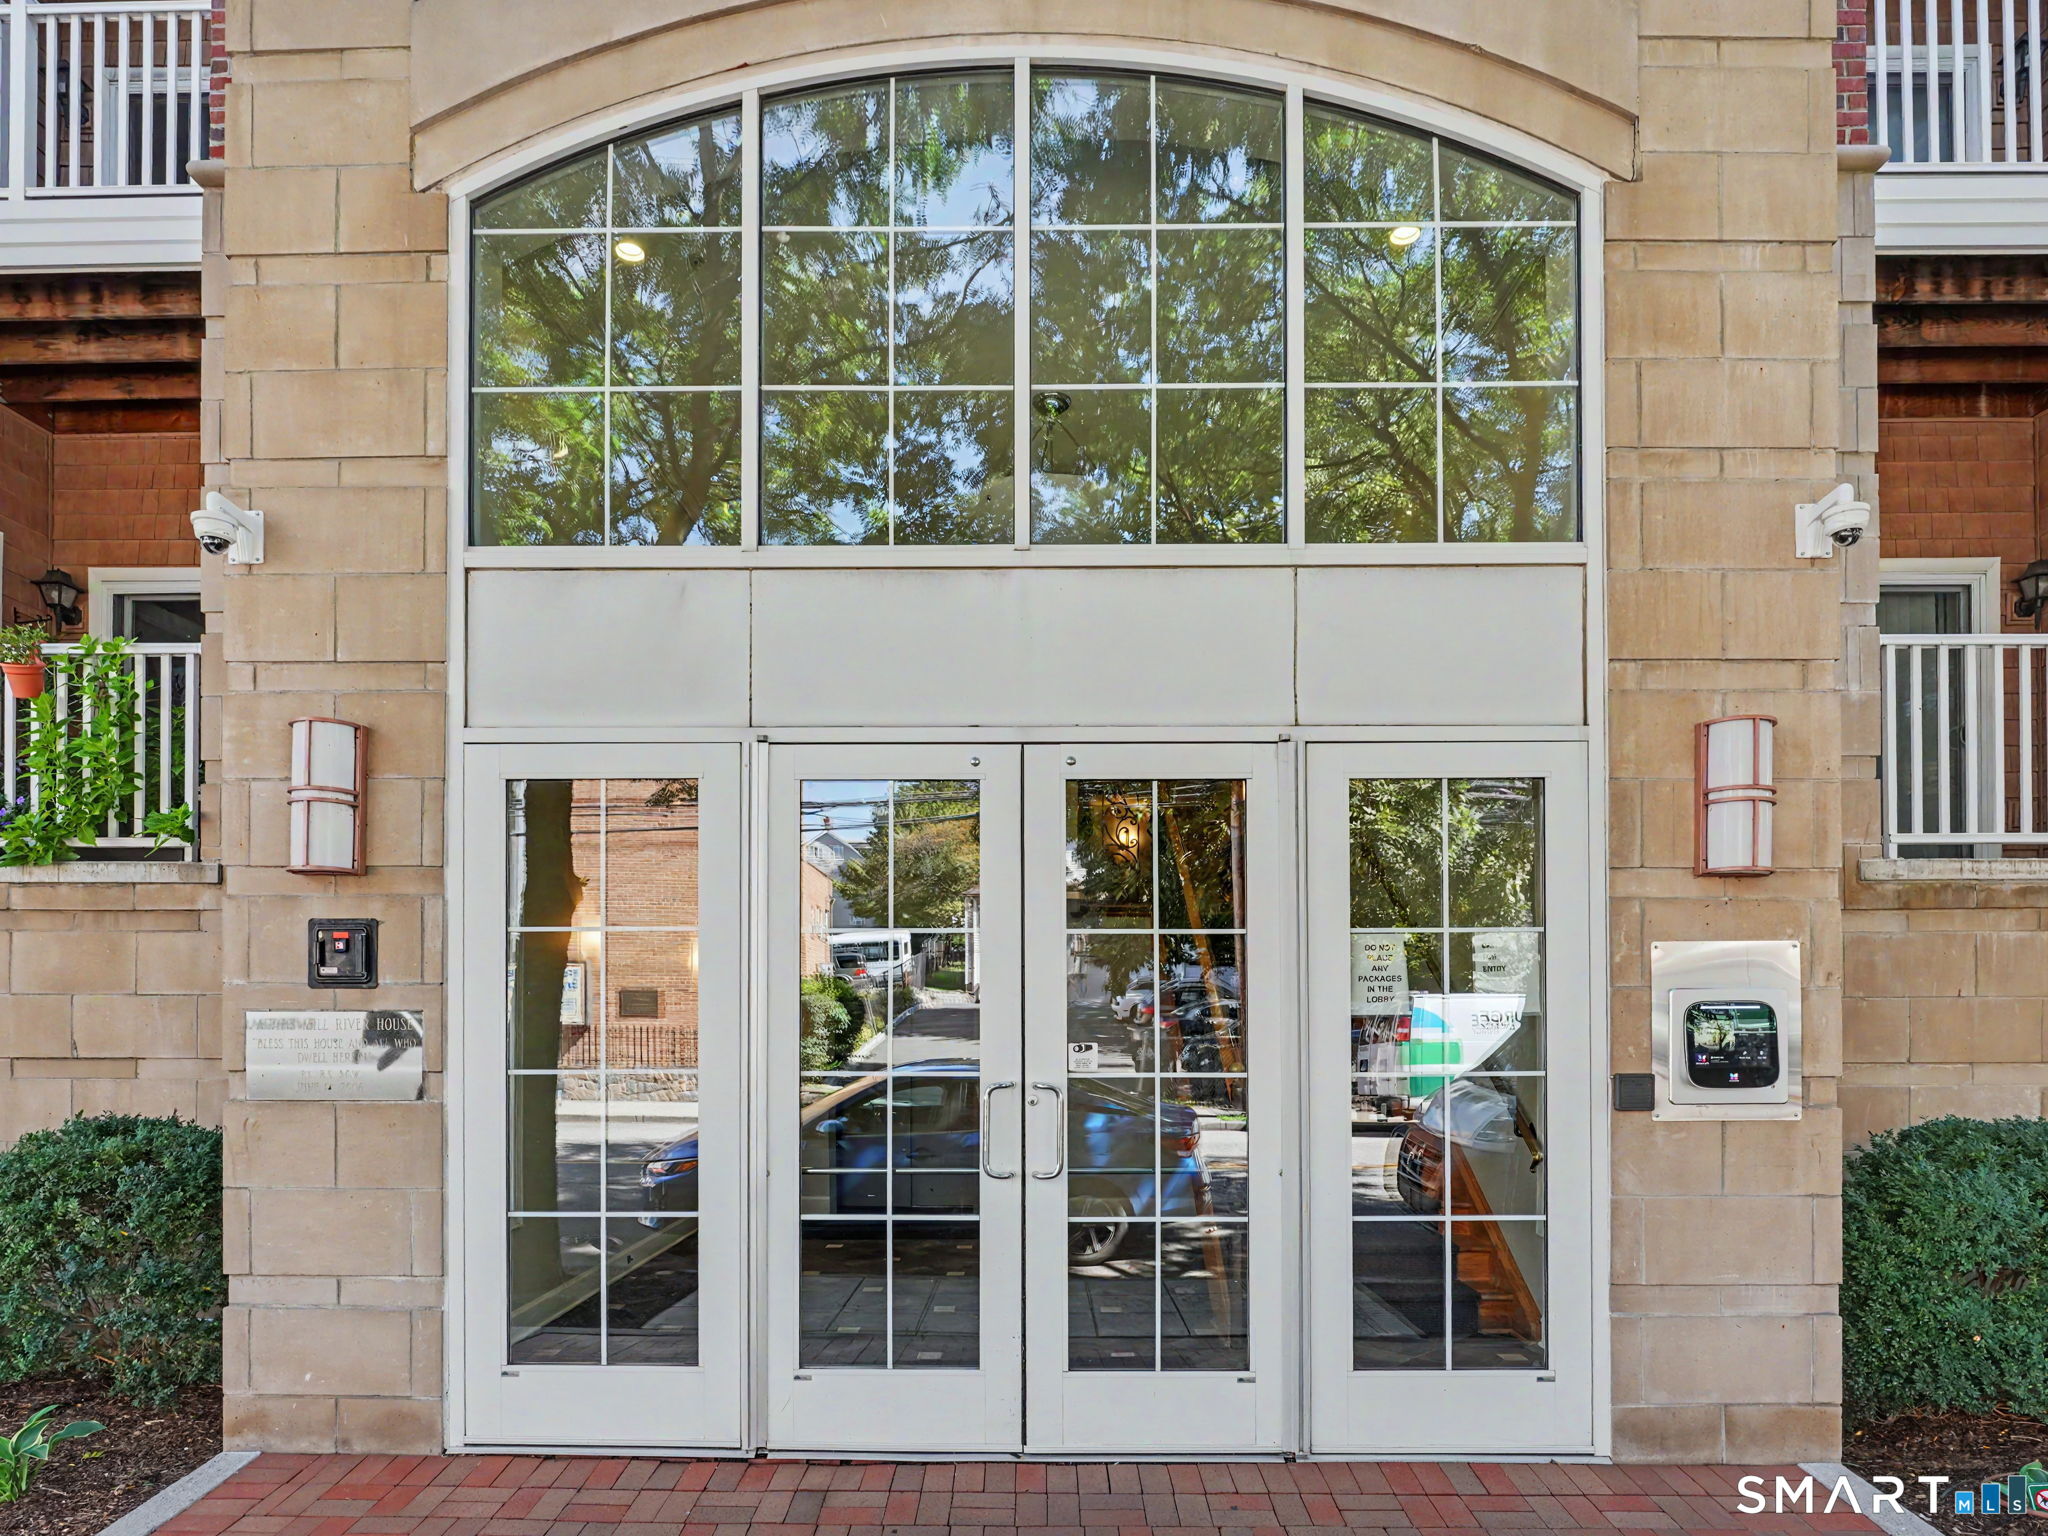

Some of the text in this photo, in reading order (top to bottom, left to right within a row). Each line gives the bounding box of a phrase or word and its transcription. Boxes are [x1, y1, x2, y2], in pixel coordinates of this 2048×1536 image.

[335, 1017, 370, 1031] RIVER
[376, 1017, 413, 1031] HOUSE
[288, 1038, 308, 1049] THIS
[314, 1038, 343, 1049] HOUSE
[349, 1038, 368, 1049] AND
[394, 1037, 417, 1049] WHO
[297, 1052, 328, 1064] DWELL
